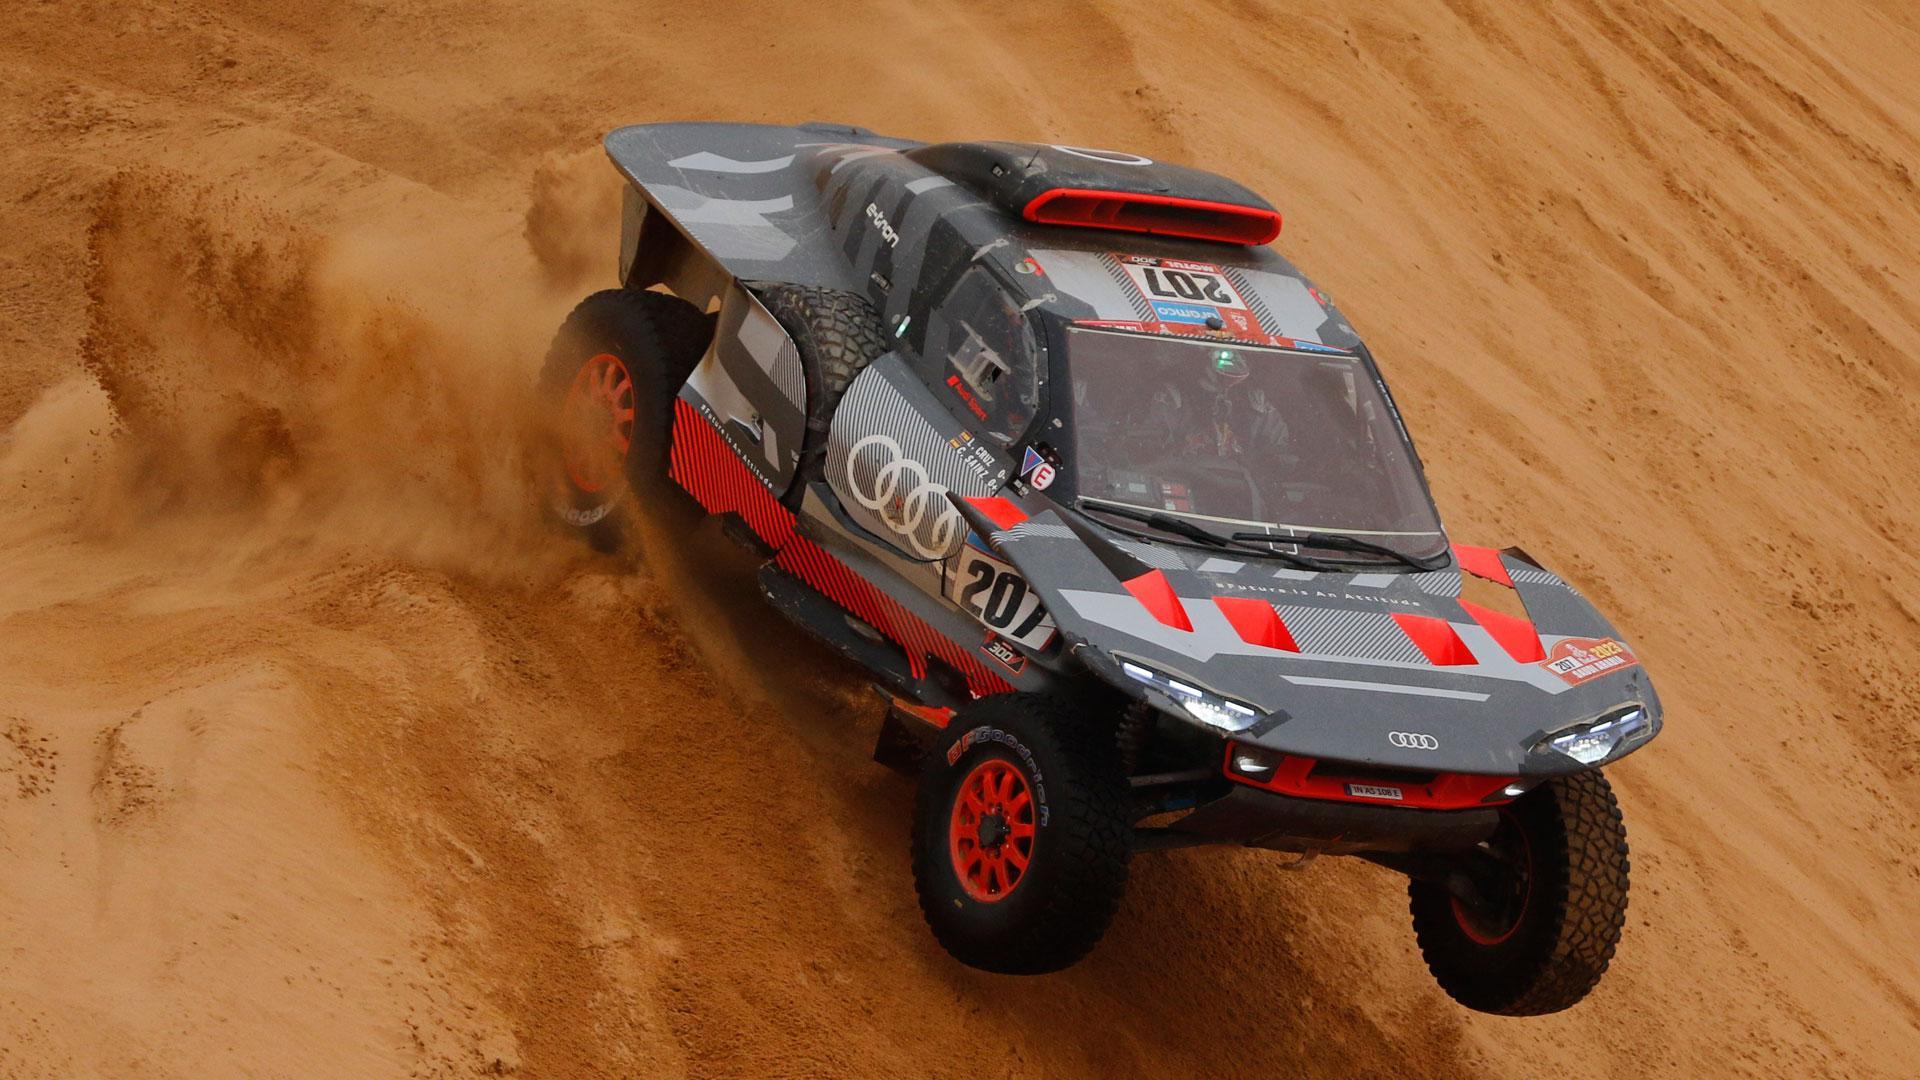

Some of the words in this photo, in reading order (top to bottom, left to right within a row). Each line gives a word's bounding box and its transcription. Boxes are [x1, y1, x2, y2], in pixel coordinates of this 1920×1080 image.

[865, 202, 900, 248] e-tron
[1165, 261, 1215, 273] MOTUL
[1142, 268, 1232, 304] 207
[964, 454, 990, 479] SAINZ
[975, 446, 996, 467] CRUZ
[1033, 466, 1052, 487] E
[960, 559, 1048, 639] 207
[1345, 593, 1421, 607] Attitude
[1590, 642, 1623, 659] 2023
[1555, 659, 1576, 671] 207
[946, 725, 1050, 828] BFGoodrich
